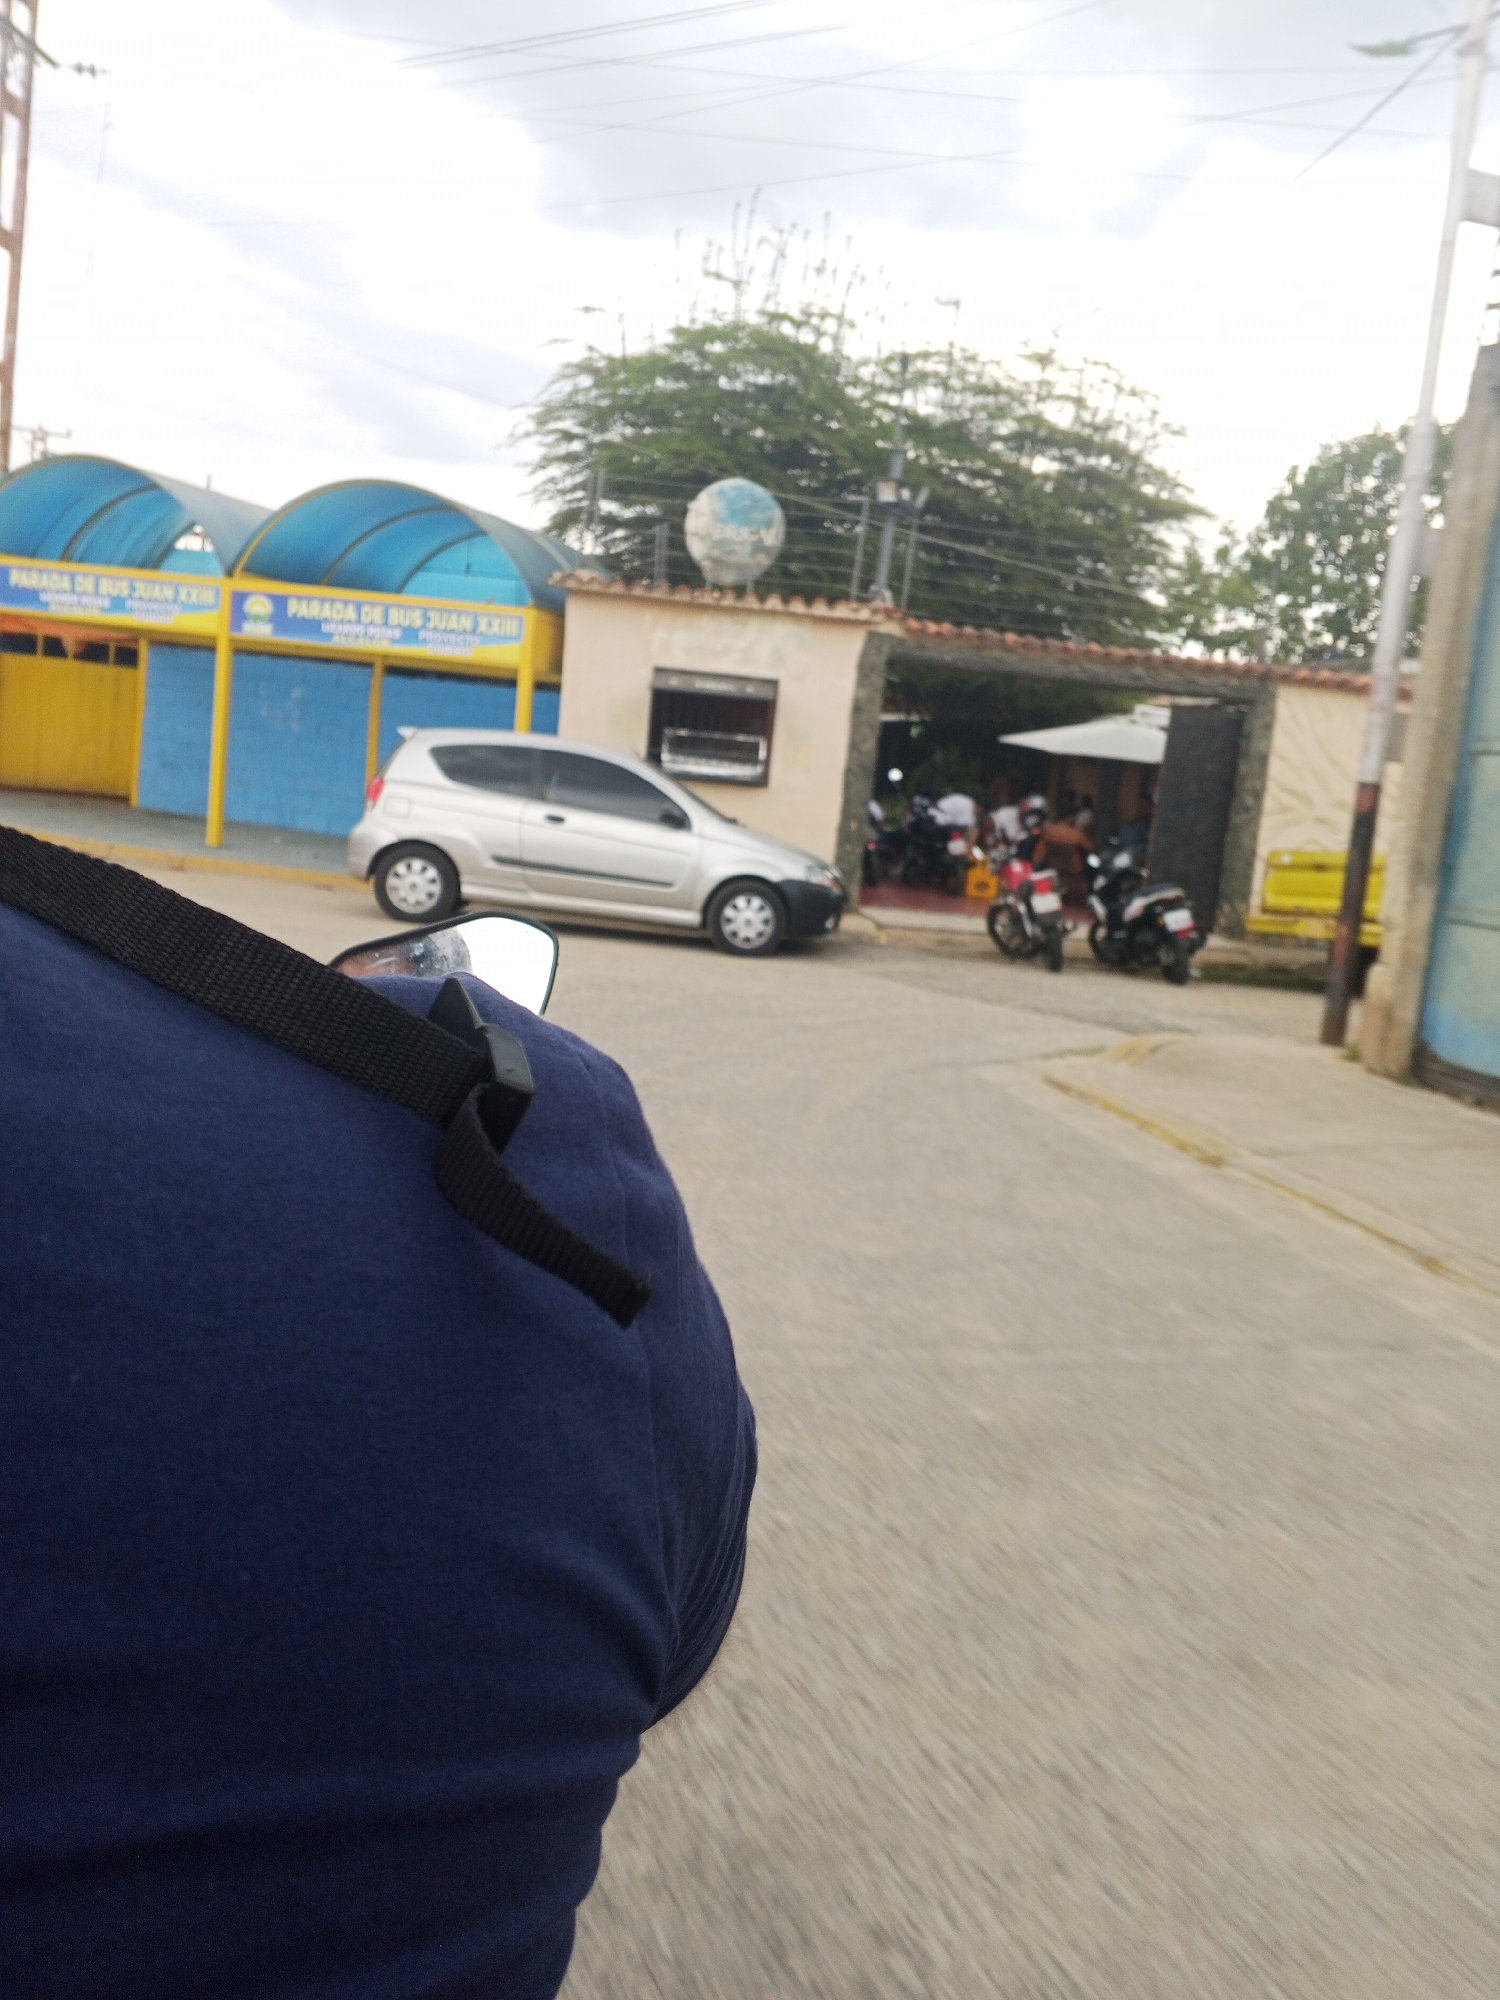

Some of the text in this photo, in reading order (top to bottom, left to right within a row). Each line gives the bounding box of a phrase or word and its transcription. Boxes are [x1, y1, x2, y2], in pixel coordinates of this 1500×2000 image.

[10, 569, 72, 591] PARADA
[74, 574, 95, 594] DE
[98, 576, 130, 598] BUS
[134, 580, 174, 602] JUAN
[288, 598, 519, 638] PARADA DE BUS JUAN XXIII
[418, 629, 481, 647] PROYECTO
